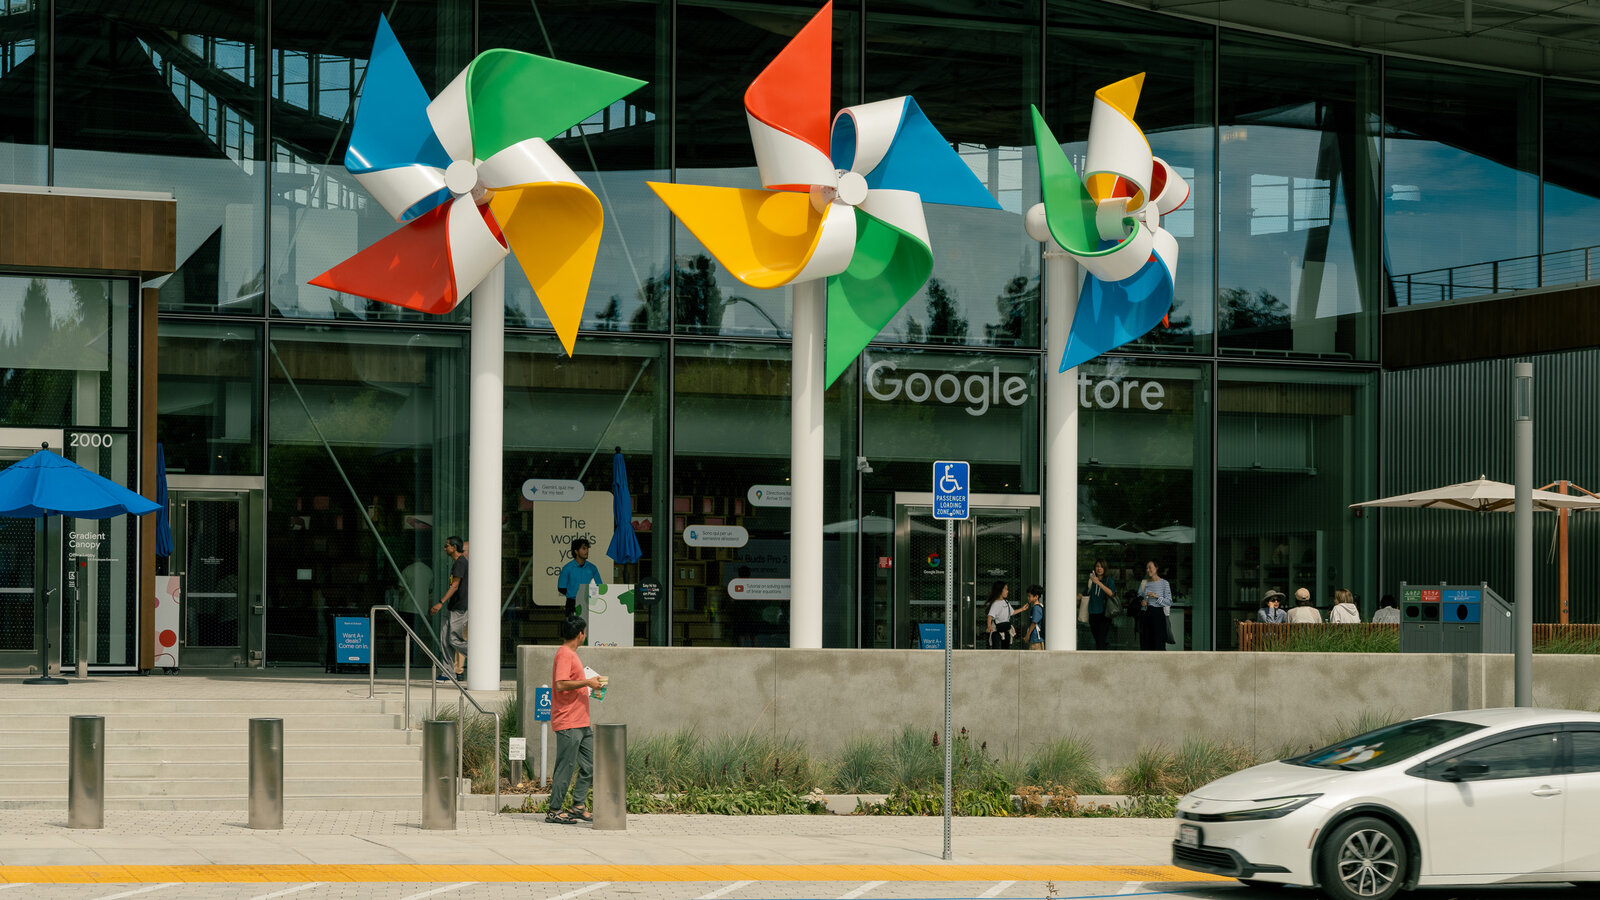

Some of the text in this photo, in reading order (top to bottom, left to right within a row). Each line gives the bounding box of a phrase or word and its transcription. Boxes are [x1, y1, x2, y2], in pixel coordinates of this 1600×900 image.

[866, 360, 1165, 416] Google tore
[70, 433, 113, 448] 2000
[561, 516, 586, 529] The
[69, 531, 106, 540] Gradient
[550, 532, 597, 545] world's
[69, 540, 101, 550] Canopy
